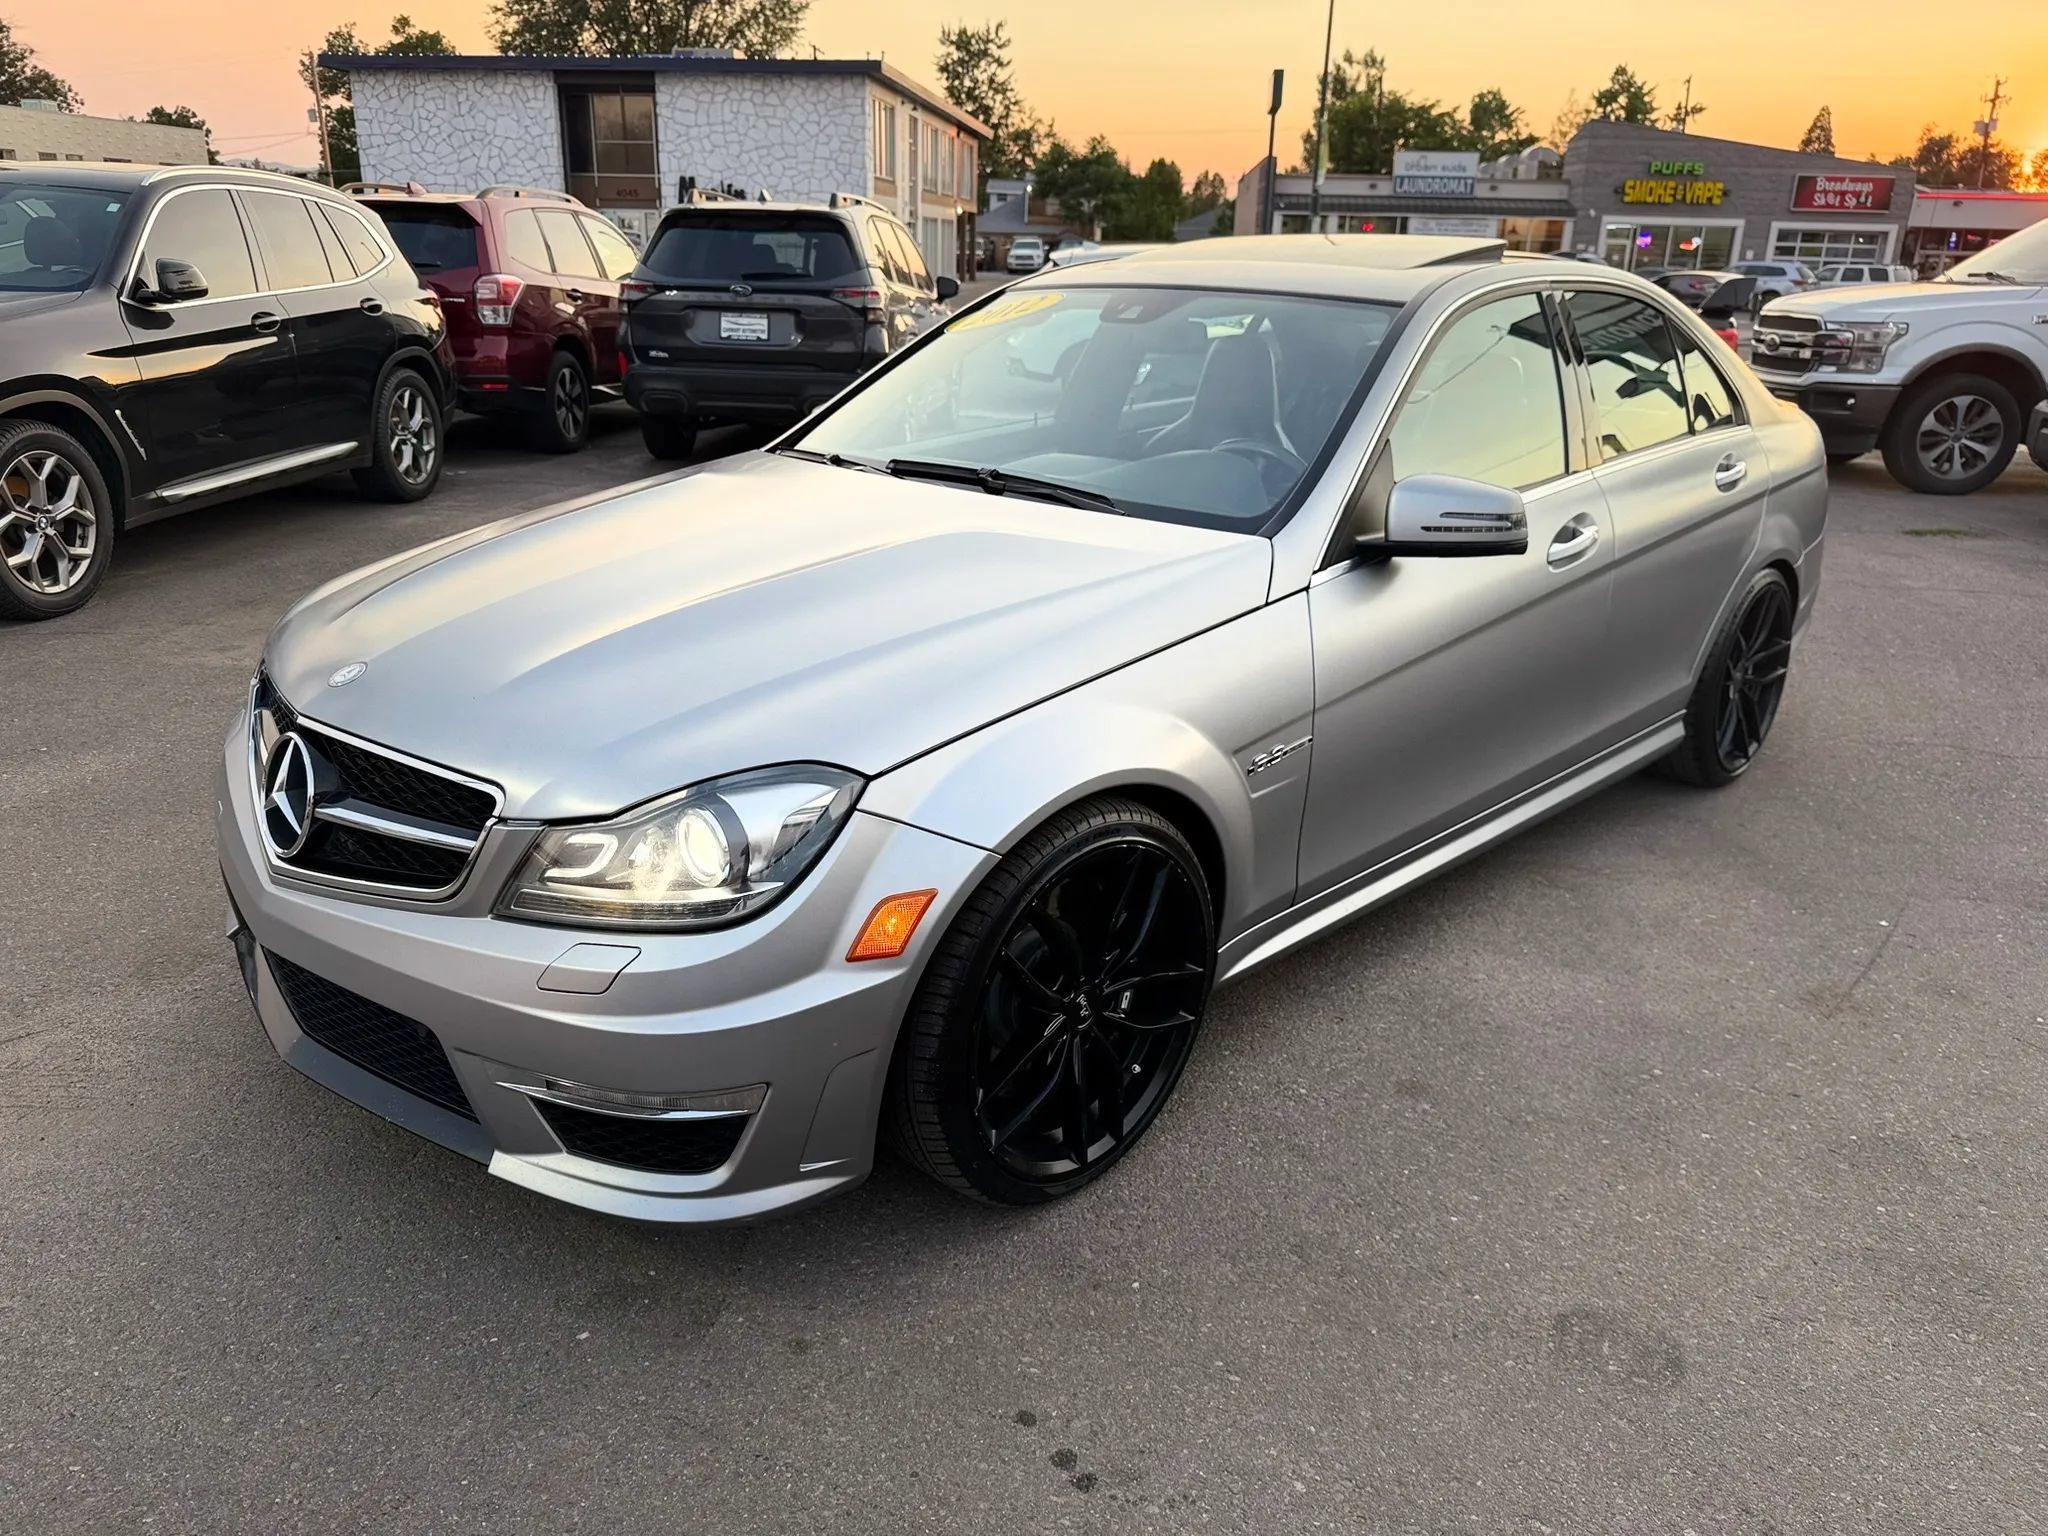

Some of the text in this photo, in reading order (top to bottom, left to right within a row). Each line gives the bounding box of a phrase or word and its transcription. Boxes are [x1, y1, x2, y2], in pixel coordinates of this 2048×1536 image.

[1649, 160, 1705, 175] PUFFS
[1396, 178, 1474, 194] LAUNDROMAT
[1623, 180, 1676, 204] SMOKE
[1685, 181, 1724, 206] VAPE
